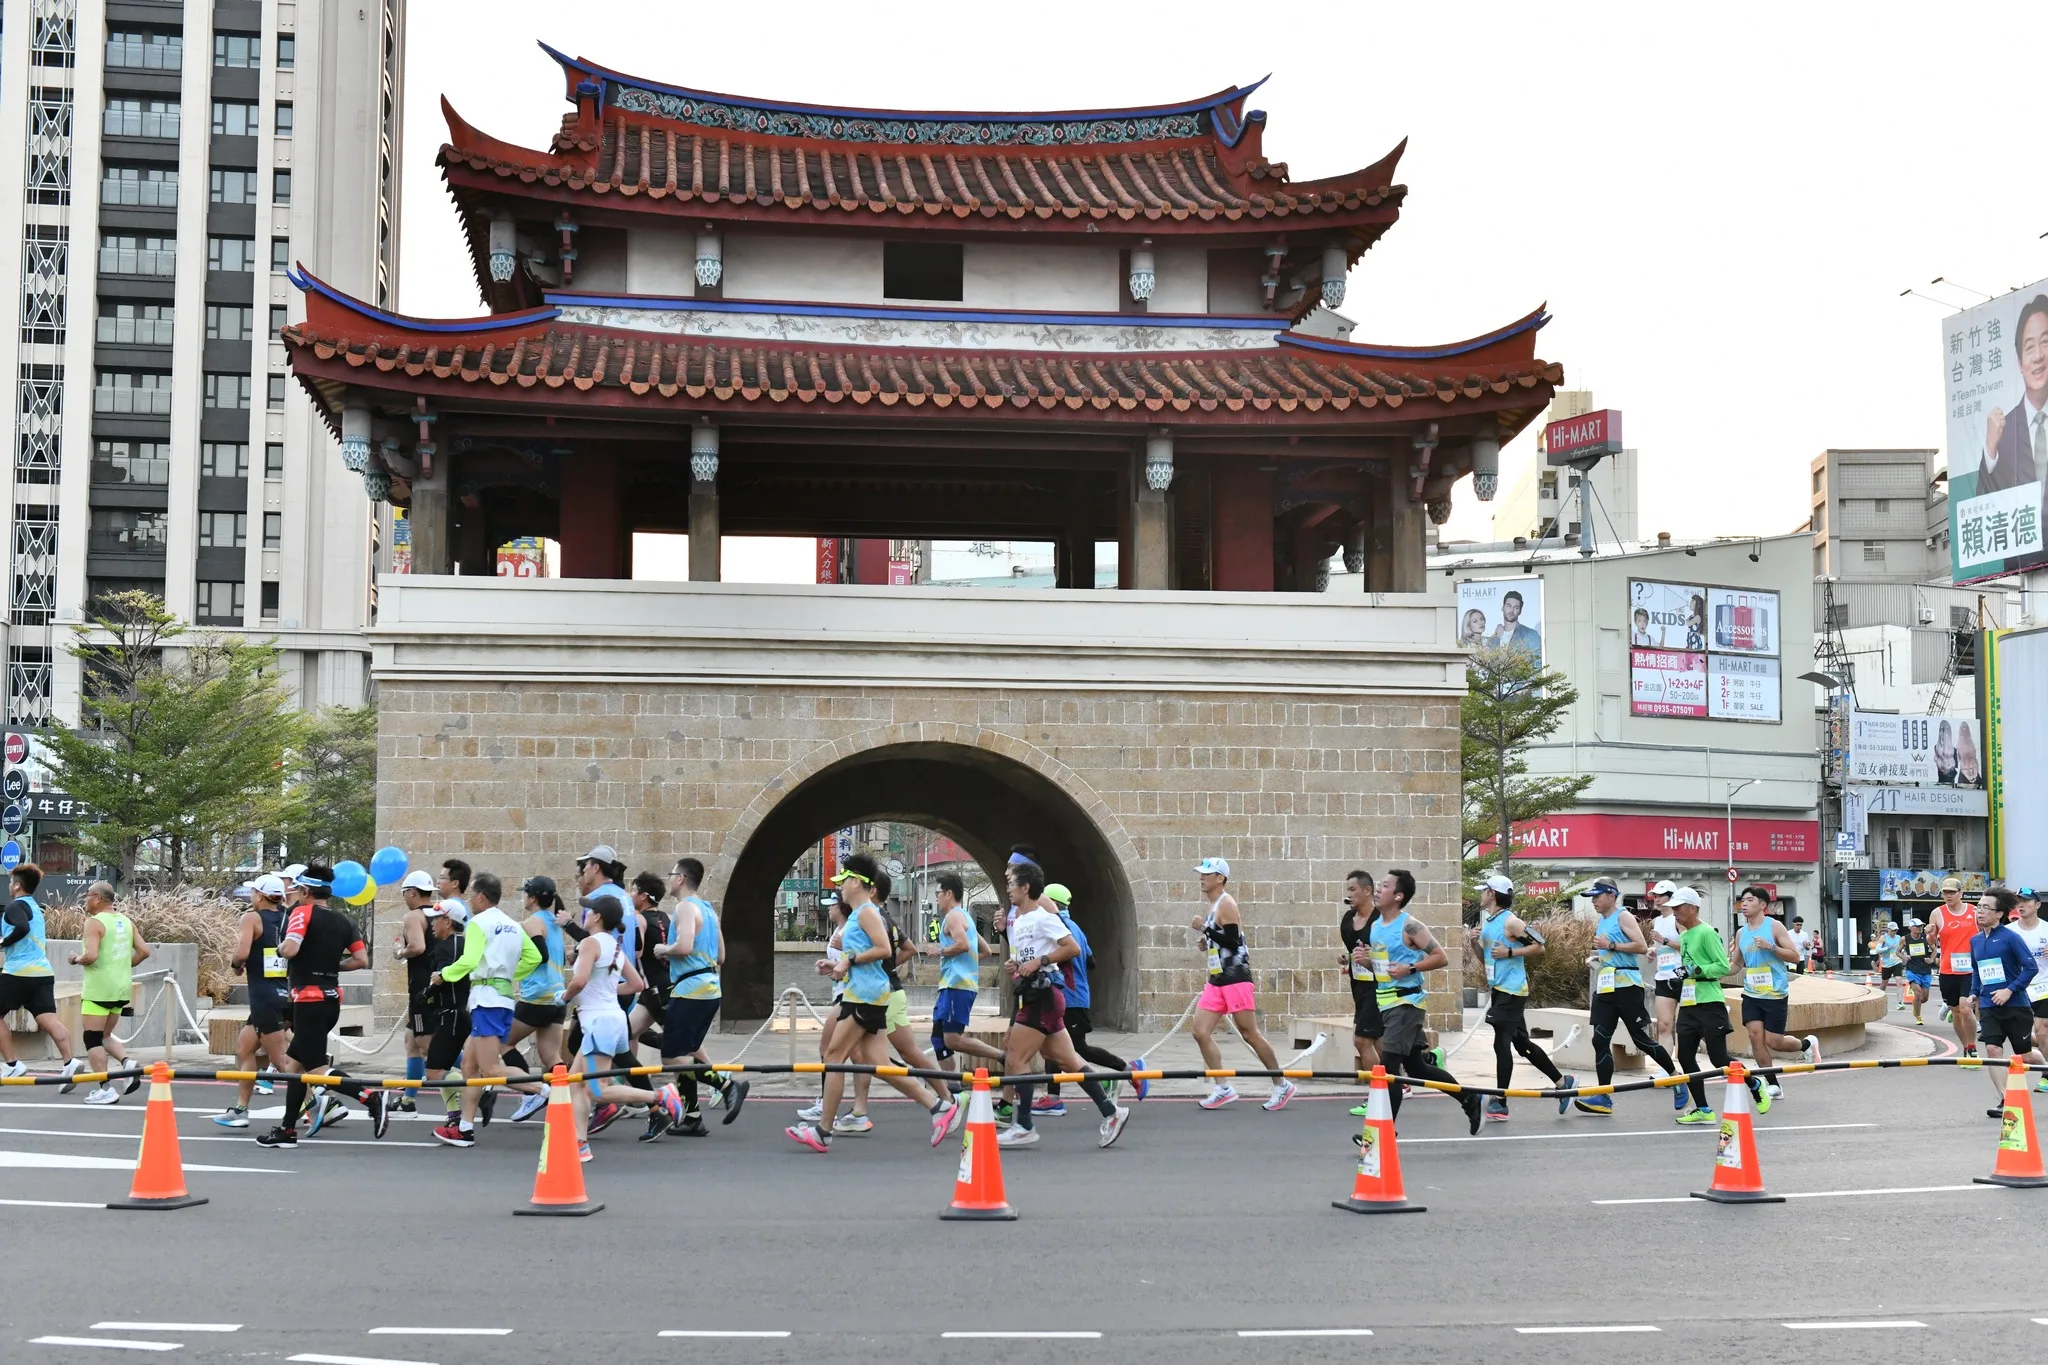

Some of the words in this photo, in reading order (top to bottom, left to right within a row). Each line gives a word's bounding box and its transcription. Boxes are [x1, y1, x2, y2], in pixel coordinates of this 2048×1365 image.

[1950, 318, 2002, 355] 新竹強
[1951, 347, 2003, 383] 台灣強
[1952, 380, 2004, 402] #TeamTaiwan
[1552, 419, 1601, 449] Hi-MART
[1961, 504, 2038, 559] 賴清德
[1462, 587, 1497, 599] Hi-MART
[1651, 611, 1686, 627] KIDS
[1716, 620, 1768, 638] Accessores
[1634, 652, 1678, 669] 熱情招商
[1719, 658, 1751, 673] Hi-MART
[1634, 680, 1643, 691] 1F
[1721, 675, 1730, 687] 3F
[1721, 687, 1730, 698] 2F
[1653, 704, 1694, 715] 0935-075091
[1722, 699, 1730, 709] 1F
[6, 744, 23, 754] EDWIN
[6, 780, 21, 791] Lee
[38, 799, 91, 816] 牛仔工
[1867, 789, 1900, 812] AT
[1904, 792, 1927, 802] HAIR
[1930, 793, 1964, 804] DESIGN
[1663, 828, 1719, 850] Hi-MART
[3, 855, 20, 863] NCAA
[66, 877, 87, 885] DENIM
